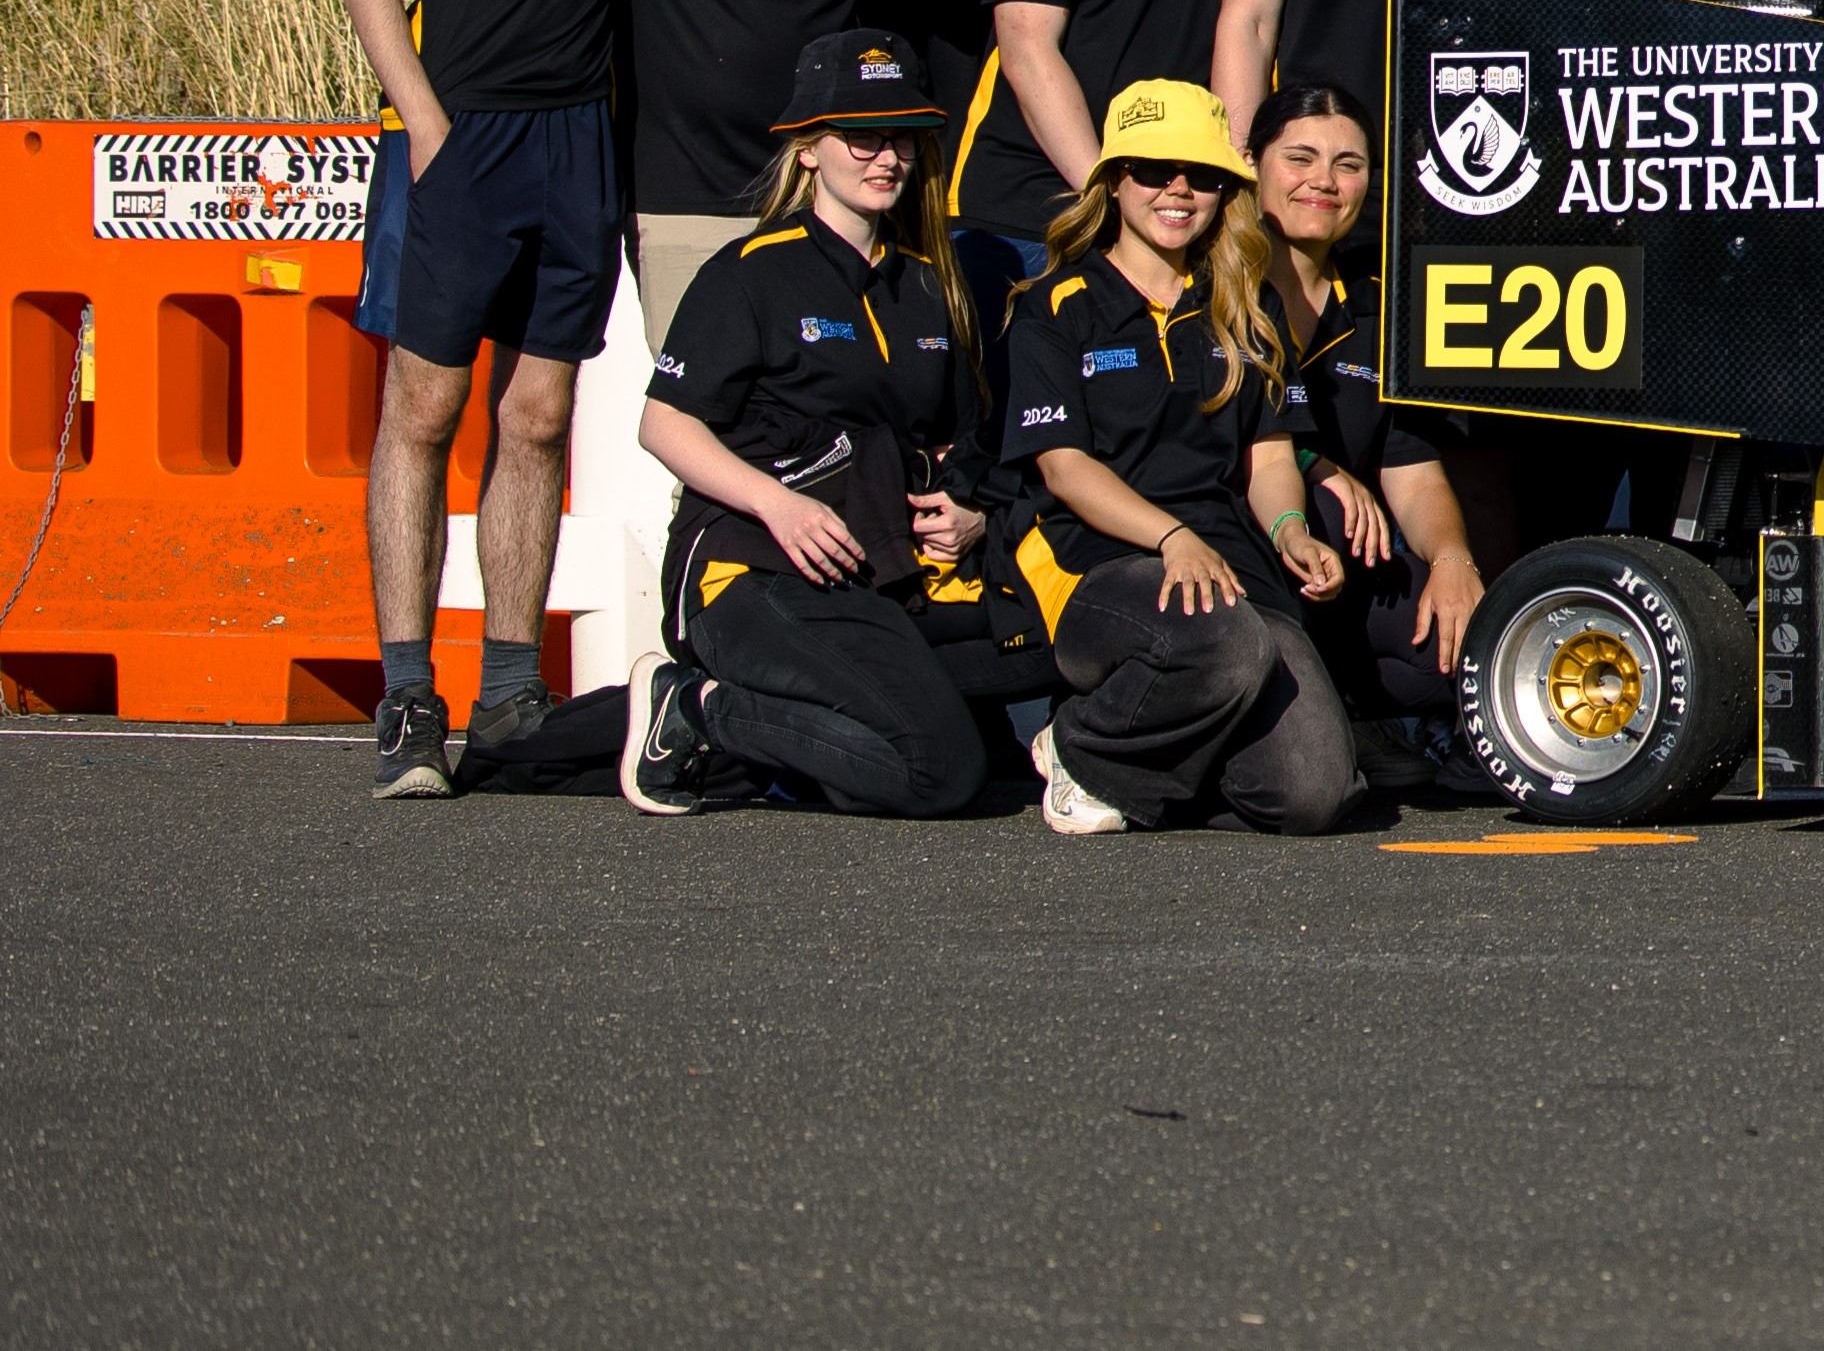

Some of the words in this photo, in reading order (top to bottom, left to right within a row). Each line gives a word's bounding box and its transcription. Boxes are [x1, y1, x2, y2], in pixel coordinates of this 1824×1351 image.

[860, 63, 901, 75] SYDNEY
[1558, 47, 1618, 78] THE
[1631, 42, 1822, 76] UNIVERSITY
[109, 154, 260, 182] BARRIER
[116, 195, 164, 215] HIRE
[190, 202, 250, 221] 1800
[316, 202, 362, 220] 003
[1435, 186, 1466, 209] SEEK
[1471, 186, 1523, 211] WISDOM
[1425, 264, 1627, 371] E20
[655, 353, 685, 379] 024
[1021, 405, 1068, 427] 2024
[1612, 565, 1687, 716] Hoosier
[1461, 654, 1537, 802] Hoosier
